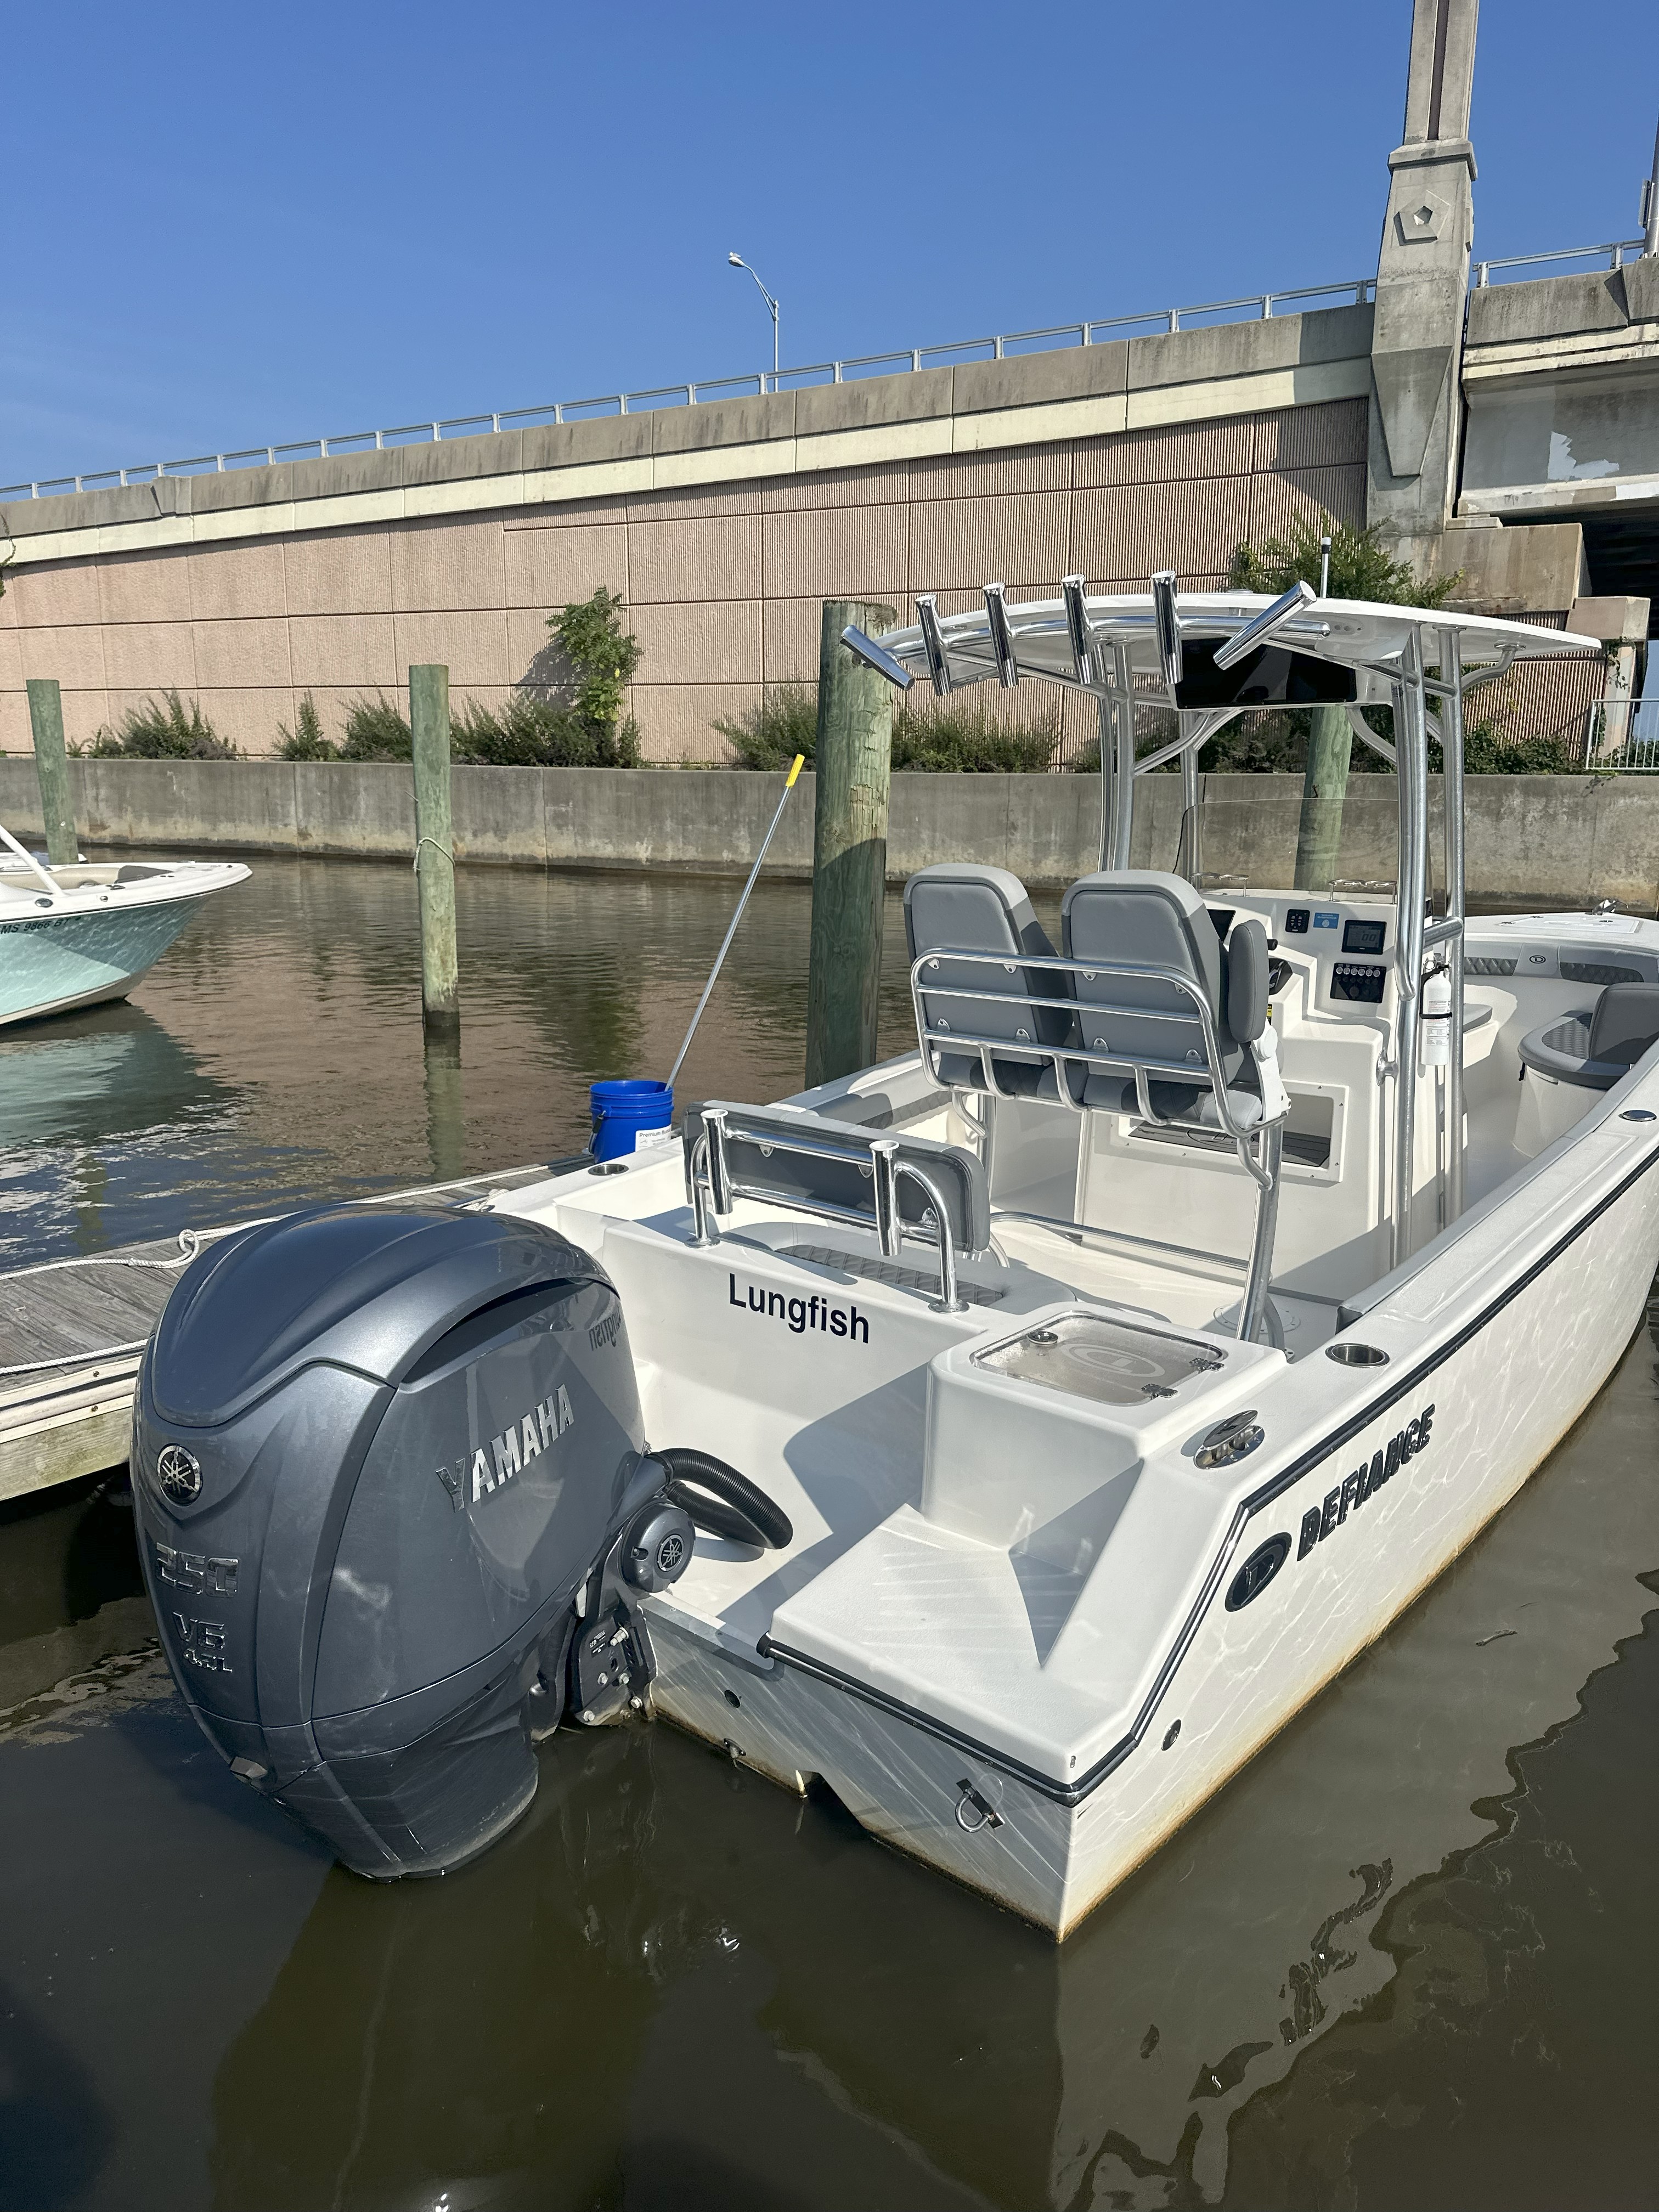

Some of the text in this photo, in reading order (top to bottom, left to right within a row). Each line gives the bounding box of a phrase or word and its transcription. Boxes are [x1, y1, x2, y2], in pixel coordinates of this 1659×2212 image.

[1, 924, 20, 934] MS
[730, 1273, 868, 1344] Lungfish
[435, 1384, 574, 1513] YAMAHA
[1297, 1403, 1435, 1562] DEFIANCE
[156, 1542, 239, 1598] 250
[173, 1611, 225, 1650] V6
